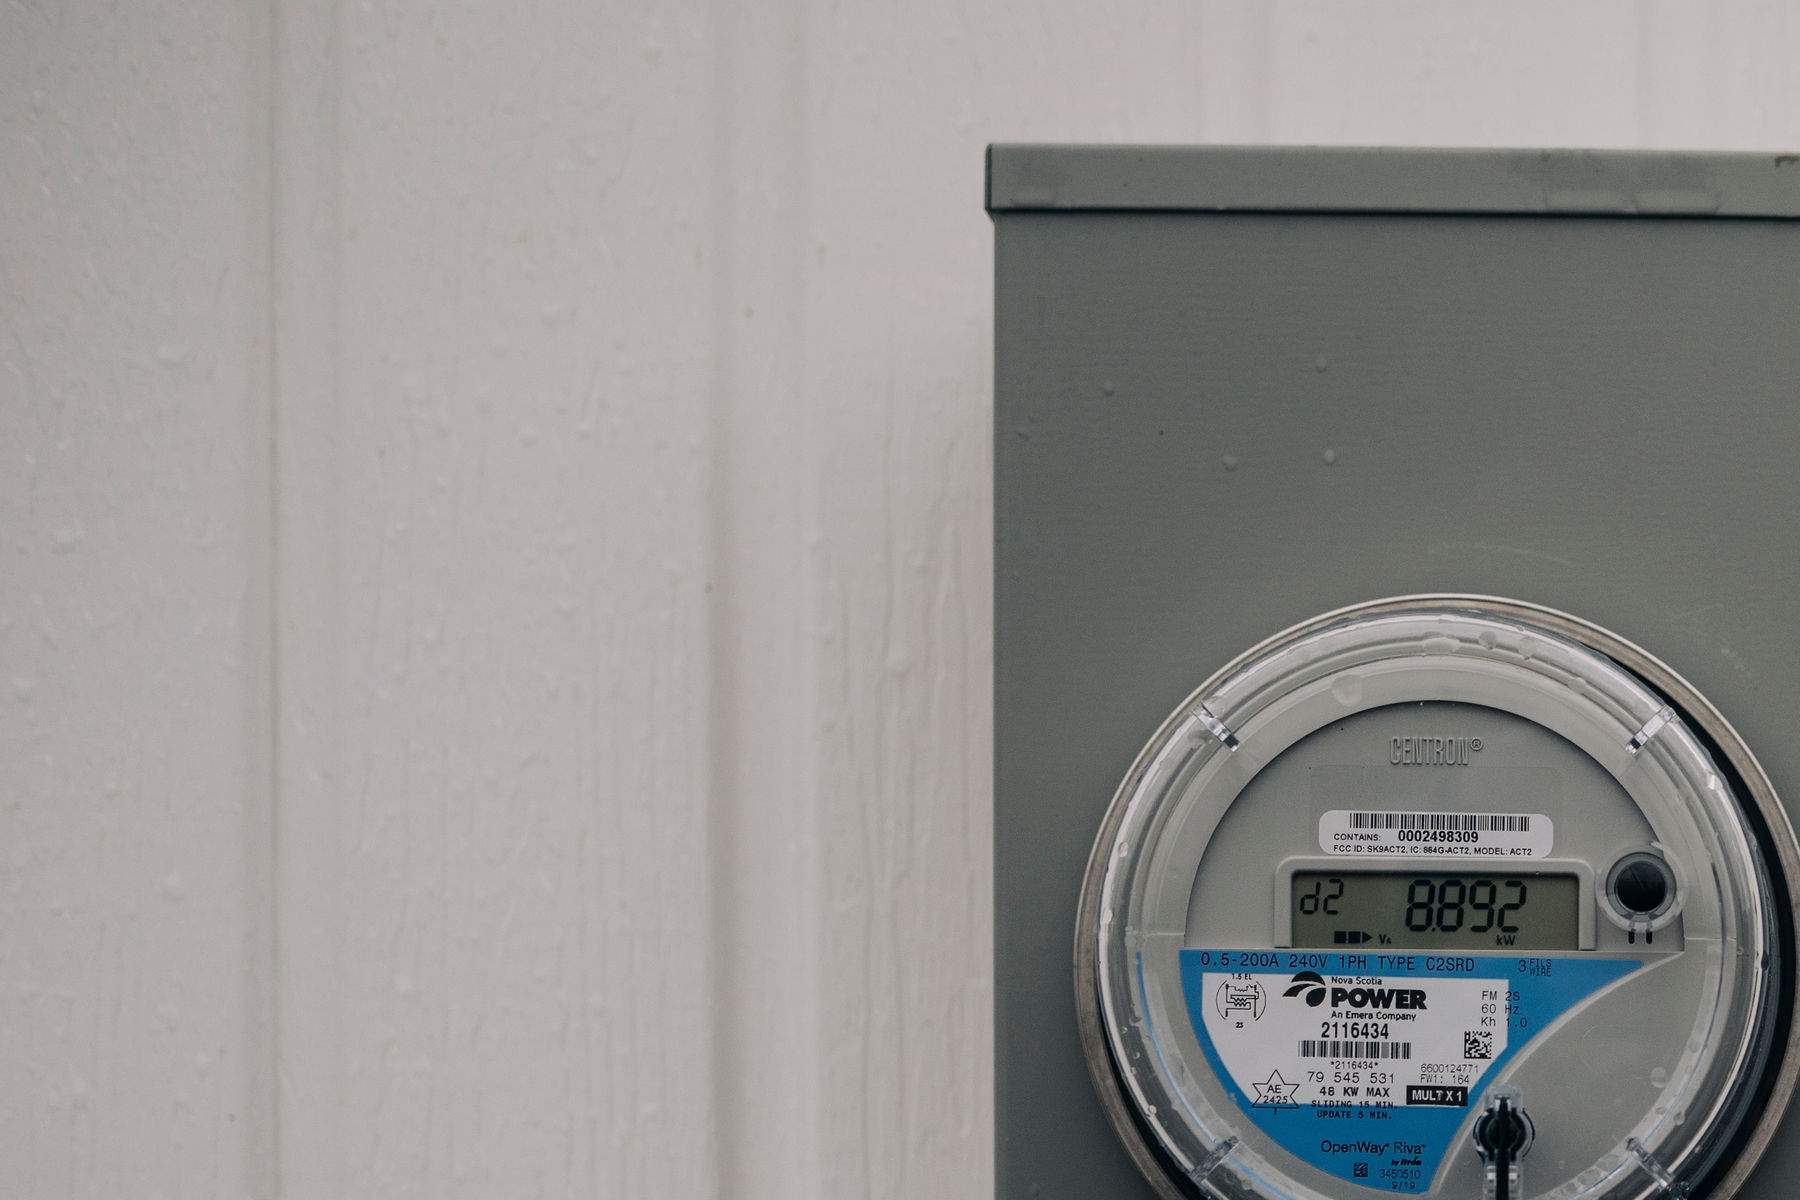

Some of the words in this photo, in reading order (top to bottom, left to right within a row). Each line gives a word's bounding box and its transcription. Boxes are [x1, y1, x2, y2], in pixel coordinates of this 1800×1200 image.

[1333, 833, 1382, 842] CONTAINS:
[1398, 830, 1479, 843] 0002498309
[1333, 844, 1351, 853] FCC
[1353, 845, 1365, 853] ID:
[1367, 845, 1408, 855] SK9ACT2,
[1410, 846, 1422, 854] IC:
[1473, 847, 1508, 856] MODEL:
[1510, 848, 1533, 856] ACT2
[1300, 879, 1344, 915] d2
[1405, 879, 1527, 933] 8.892
[1496, 935, 1516, 946] kW
[1201, 952, 1279, 967] 0.5-200A
[1289, 955, 1328, 968] 240V
[1339, 956, 1367, 969] 1PH
[1377, 956, 1415, 970] TYPE
[1426, 957, 1475, 972] C2SRD
[1518, 960, 1527, 973] 3
[1529, 958, 1552, 968] FILS
[1529, 968, 1552, 977] WIRE
[1331, 977, 1353, 985] Nova
[1356, 977, 1383, 985] Scotia
[1331, 988, 1427, 1010] POWER
[1481, 991, 1498, 1000] FM
[1505, 991, 1520, 1001] 2S
[1481, 1004, 1497, 1014] 60
[1505, 1005, 1519, 1014] Hz
[1331, 1011, 1343, 1019] An
[1345, 1011, 1374, 1020] Emera
[1376, 1012, 1417, 1021] Company
[1480, 1017, 1496, 1027] Kh
[1506, 1017, 1528, 1027] 1.0
[1321, 1022, 1389, 1039] 2116434
[1420, 1064, 1479, 1073] 6600124771
[1307, 1071, 1324, 1083] 79
[1334, 1072, 1360, 1083] 545
[1370, 1073, 1394, 1084] 531
[1420, 1074, 1443, 1084] FW1:
[1452, 1075, 1470, 1084] 164
[1267, 1085, 1282, 1093] AE
[1320, 1087, 1335, 1096] 48
[1343, 1087, 1359, 1097] KW
[1366, 1088, 1390, 1097] MAX
[1263, 1095, 1288, 1104] 2425
[1412, 1090, 1443, 1101] MULT
[1457, 1091, 1462, 1101] 1
[1311, 1100, 1352, 1108] SLIDING
[1375, 1101, 1398, 1109] MIN.
[1317, 1110, 1352, 1119] UPDATE
[1358, 1111, 1364, 1119] 5
[1370, 1111, 1392, 1120] MIN.
[1392, 1182, 1415, 1190] 9/19
